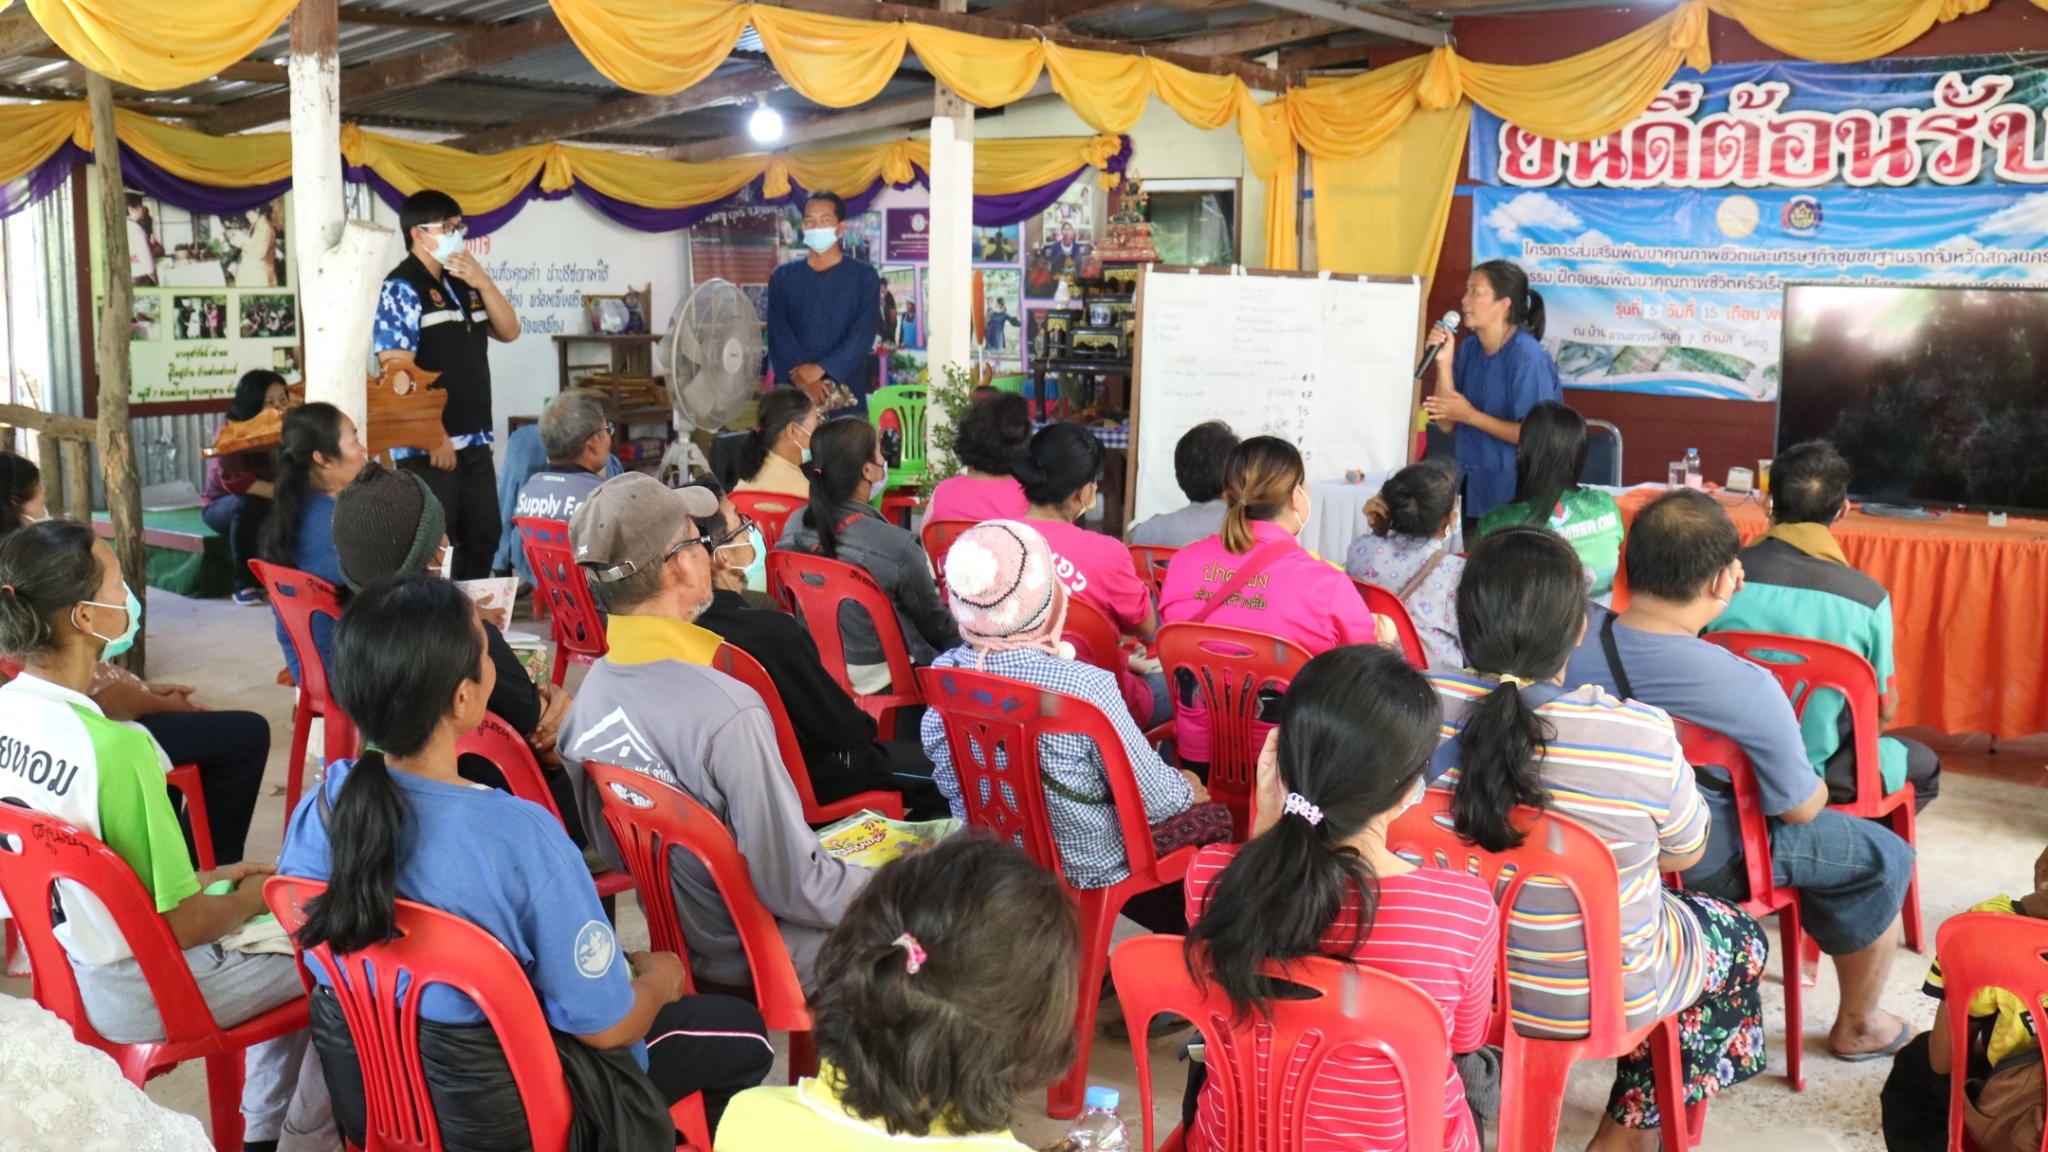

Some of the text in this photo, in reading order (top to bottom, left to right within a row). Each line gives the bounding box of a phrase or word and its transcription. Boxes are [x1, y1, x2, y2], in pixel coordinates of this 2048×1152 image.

[1502, 78, 2048, 182] ยนดีต้อนรับ
[1649, 305, 1658, 317] 5
[1667, 299, 1695, 319] วันที่
[1704, 306, 1719, 319] 15
[1727, 304, 1761, 321] เดือน
[1688, 334, 1696, 345] 7
[1703, 330, 1733, 344] ตำบล
[517, 492, 562, 519] Supply
